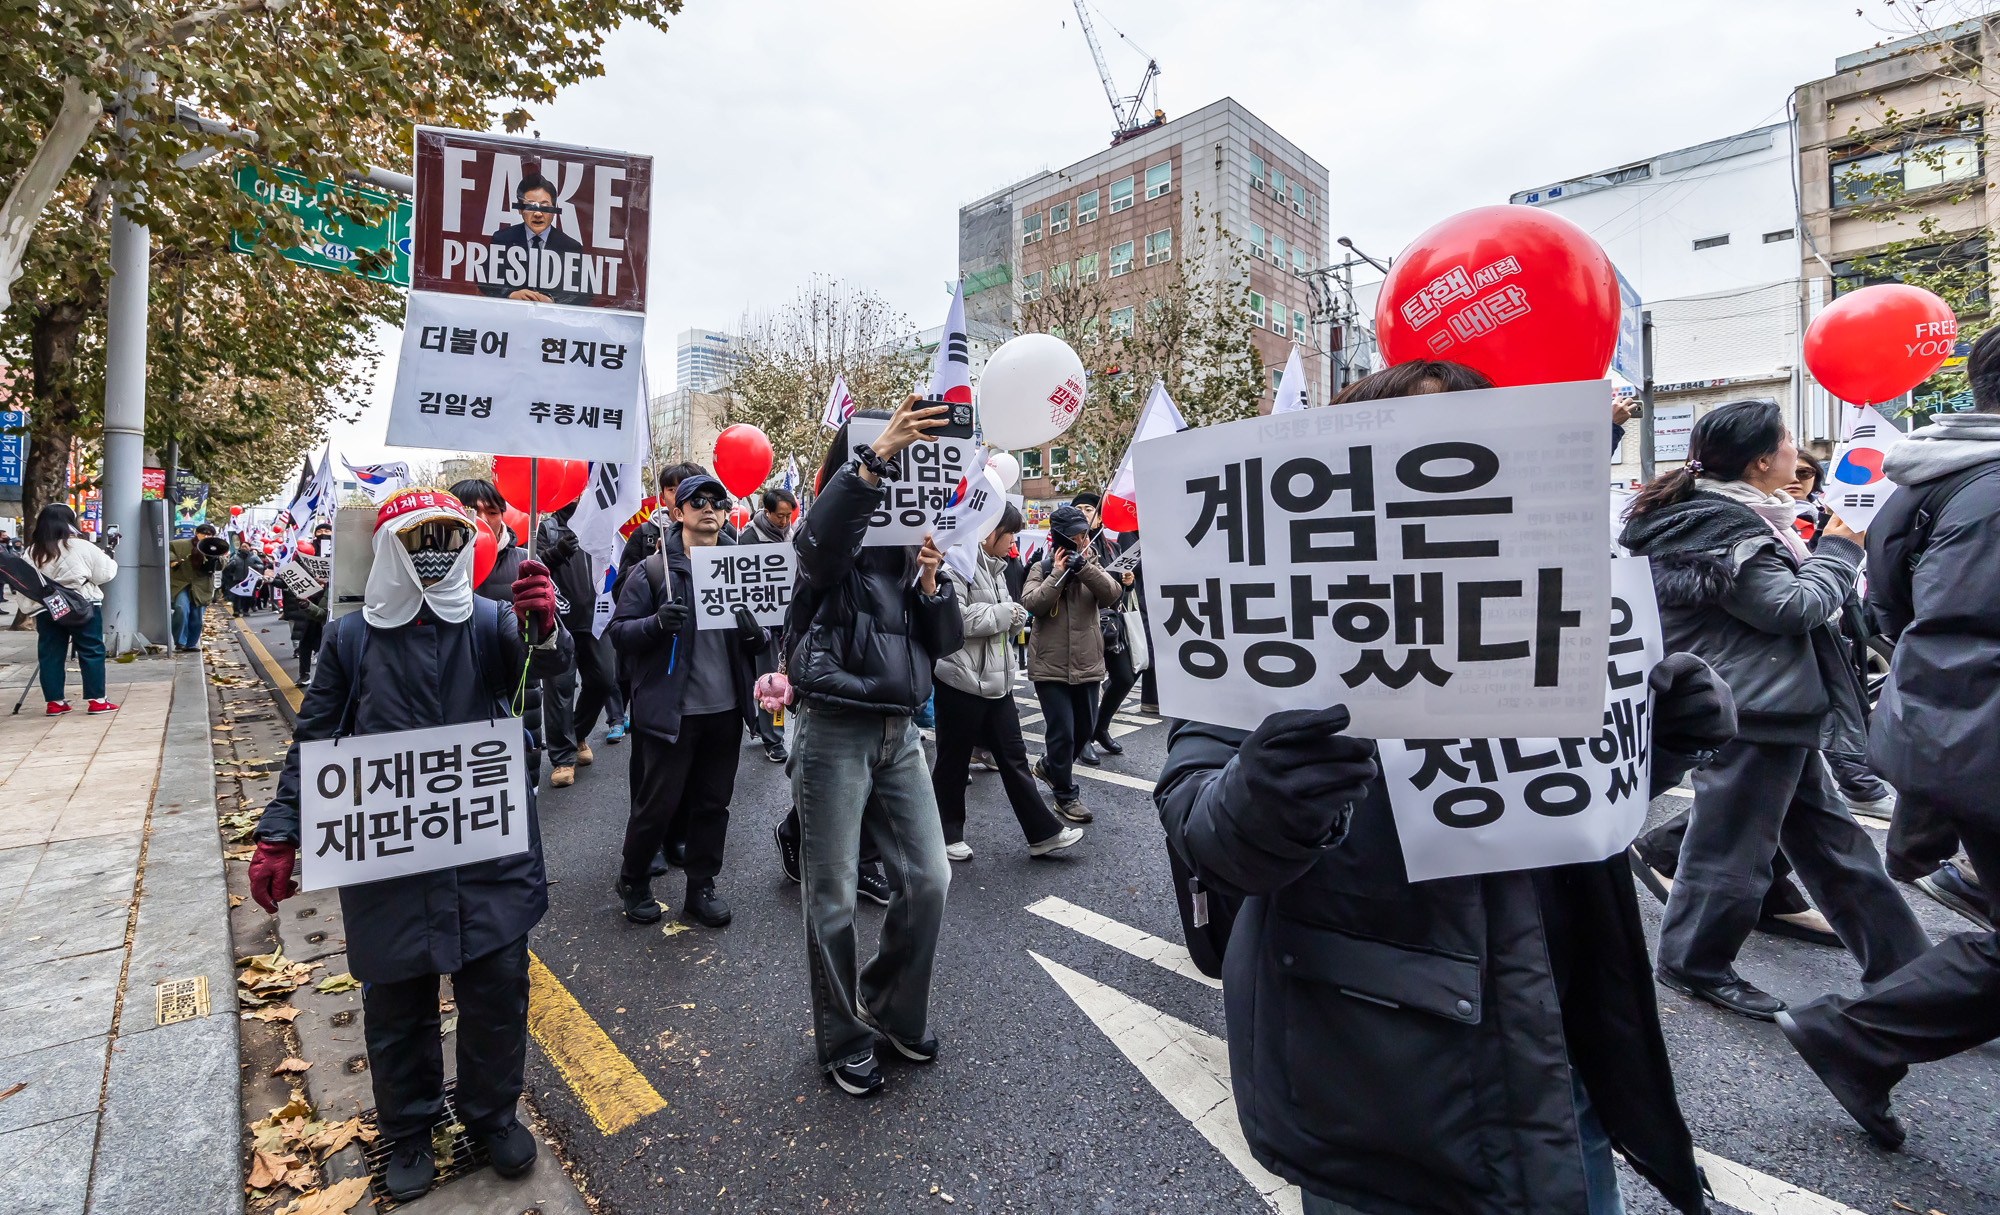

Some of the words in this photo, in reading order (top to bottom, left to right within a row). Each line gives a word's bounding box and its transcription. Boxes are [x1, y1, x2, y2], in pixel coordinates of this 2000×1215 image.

[442, 146, 626, 251] FAKE
[328, 245, 346, 262] 41
[442, 236, 622, 297] PRESIDENT
[1401, 265, 1477, 332] 탄핵
[1473, 255, 1522, 290] 세력
[1448, 284, 1531, 343] 내란
[419, 326, 509, 359] 더불어
[541, 337, 628, 370] 현지당
[1915, 320, 1956, 338] FREE
[418, 392, 493, 419] 김일성
[529, 402, 623, 430] 추종세력
[1711, 379, 1726, 387] 2F
[386, 494, 435, 514] 이재명
[1185, 441, 1513, 567] 계엄은
[711, 554, 789, 585] 계엄은
[1160, 568, 1581, 690] 정당했다
[316, 739, 512, 806] 이재명을
[316, 790, 516, 862] 재판하라
